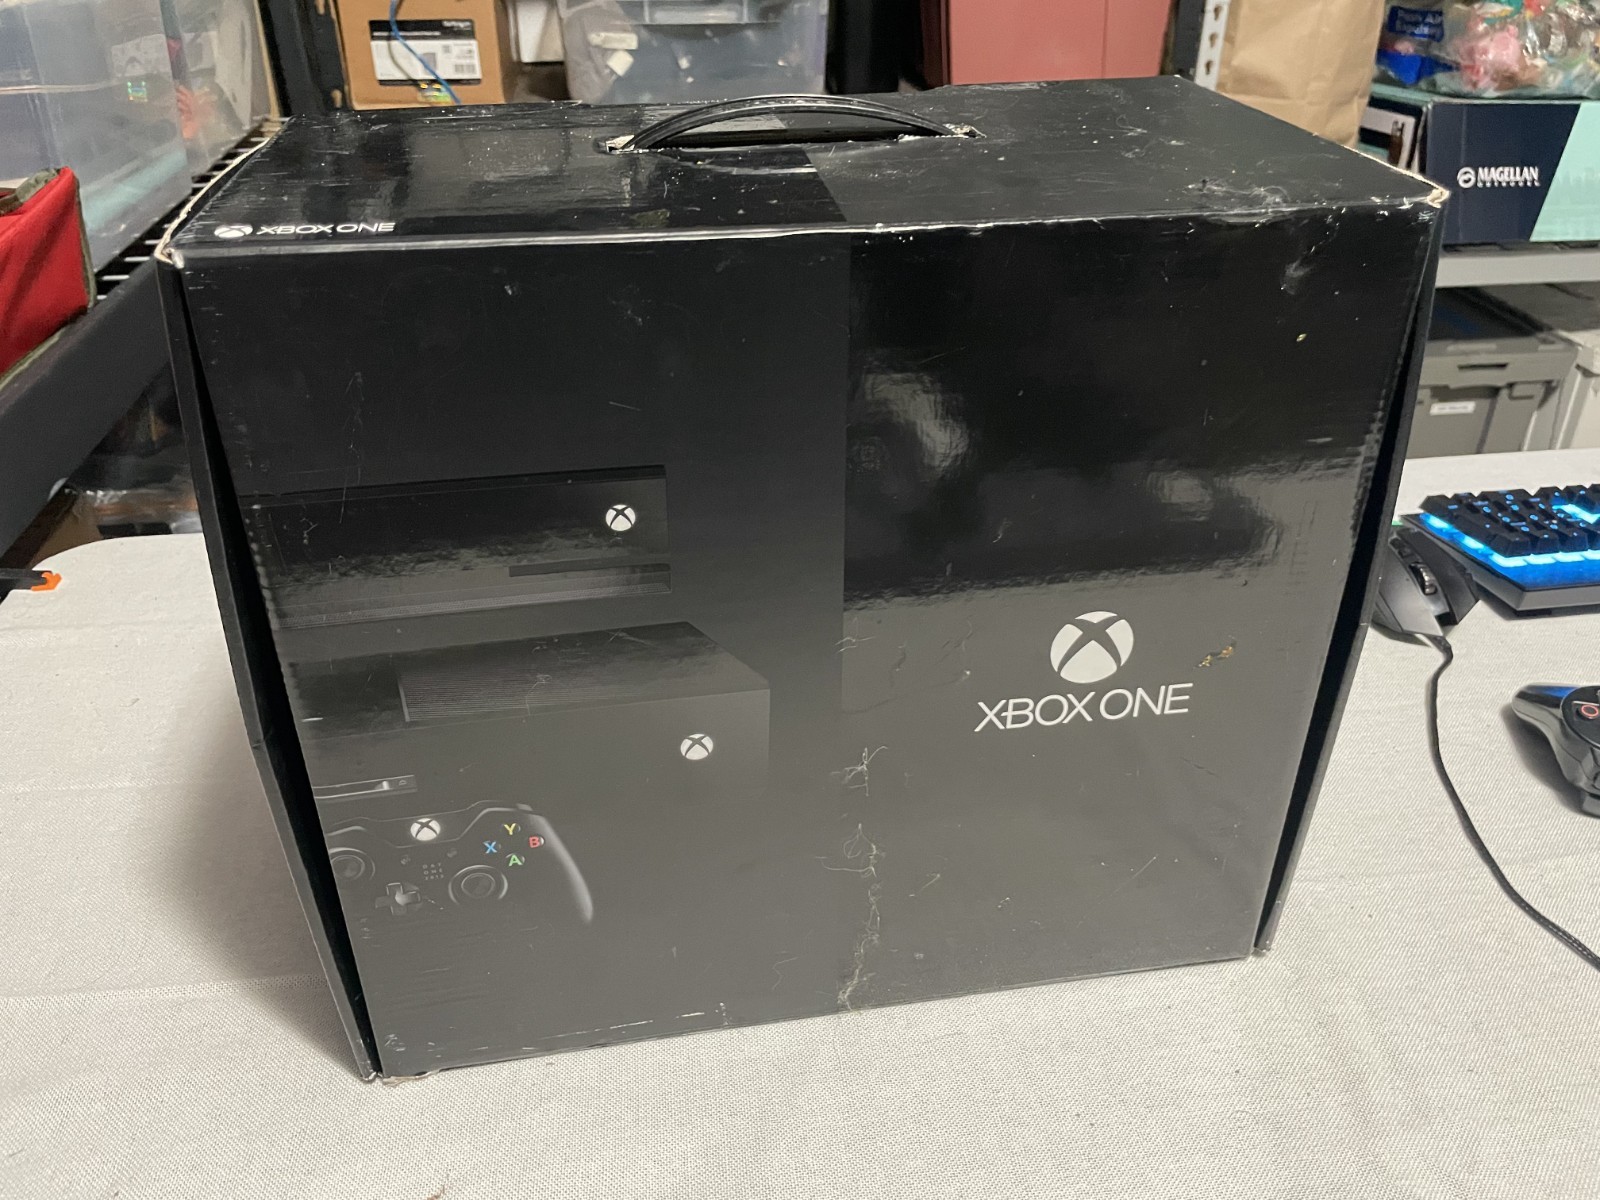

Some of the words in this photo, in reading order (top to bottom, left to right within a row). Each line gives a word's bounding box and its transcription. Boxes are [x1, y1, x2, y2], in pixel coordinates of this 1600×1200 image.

[1477, 166, 1539, 181] MAGELLAN
[256, 224, 334, 235] XBOX
[336, 222, 396, 233] ONE
[974, 691, 1096, 732] XBOX
[1099, 682, 1194, 720] ONE
[503, 822, 517, 836] Y
[483, 841, 498, 854] X
[528, 836, 541, 849] B
[508, 854, 523, 867] A
